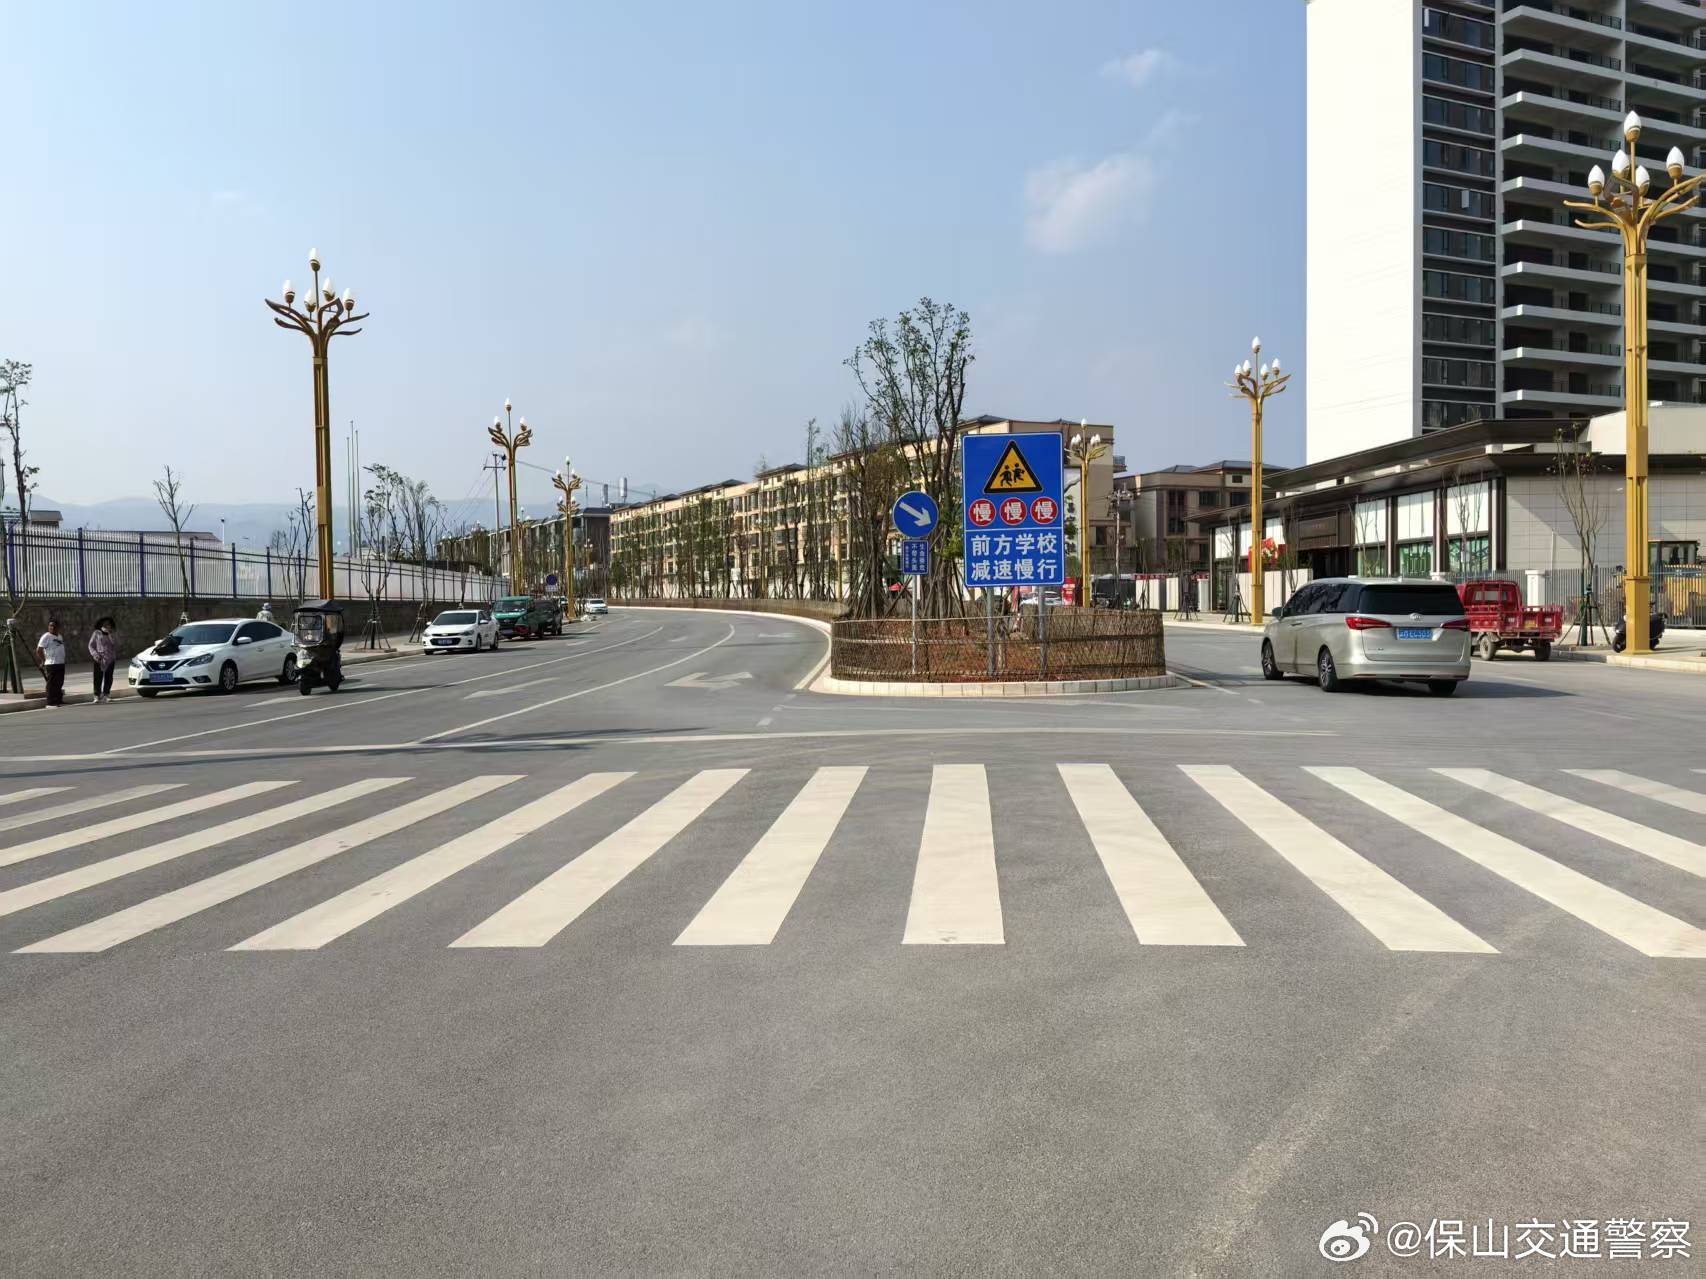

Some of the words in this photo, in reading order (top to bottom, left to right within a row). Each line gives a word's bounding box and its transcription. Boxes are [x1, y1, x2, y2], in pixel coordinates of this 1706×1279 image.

[973, 503, 992, 522] 慢
[1004, 502, 1023, 521] 慢
[1035, 501, 1054, 520] 慢
[971, 533, 1057, 556] 前方学校
[971, 558, 1057, 581] 减速慢行
